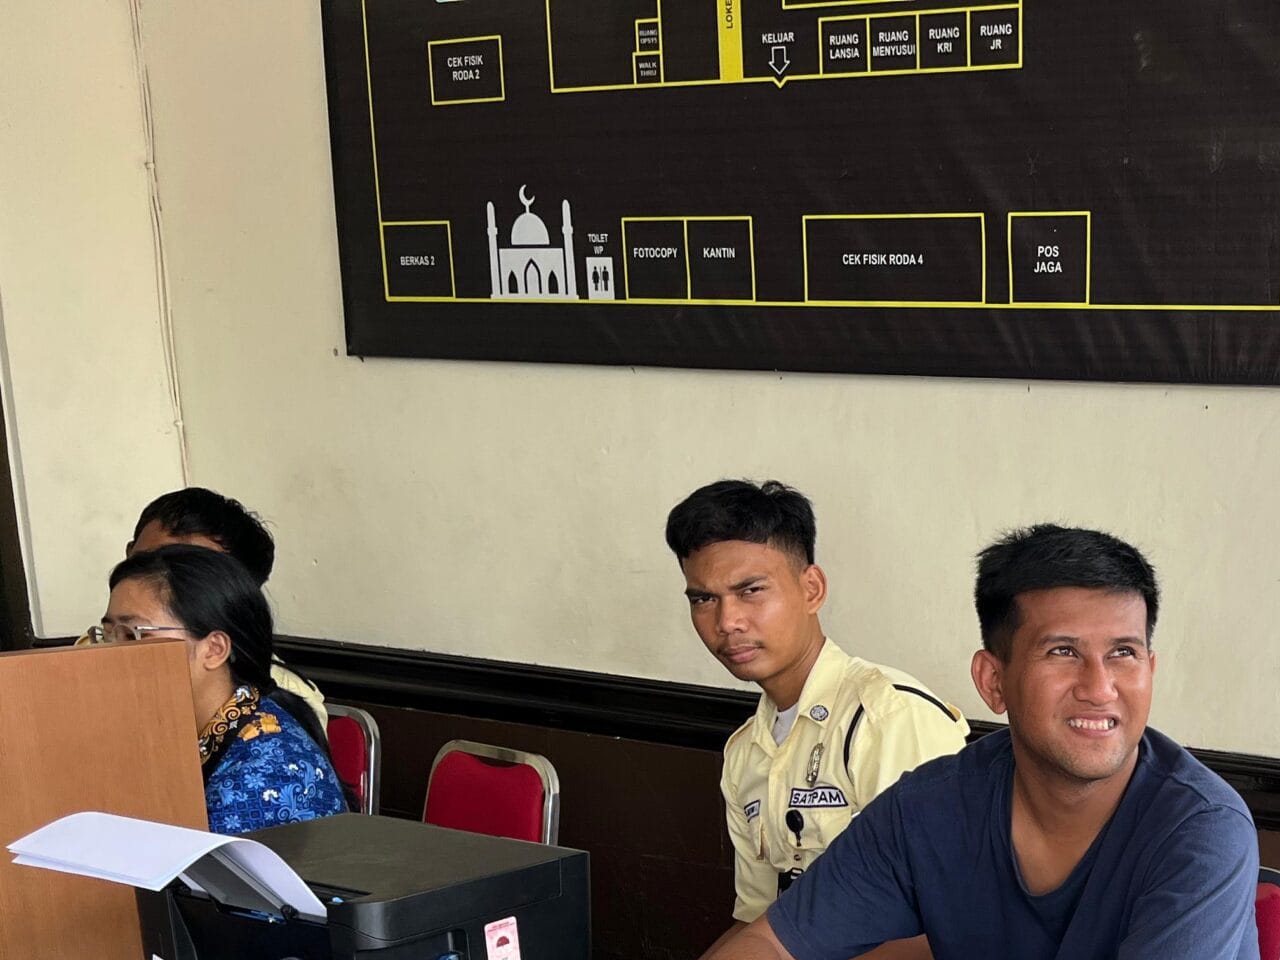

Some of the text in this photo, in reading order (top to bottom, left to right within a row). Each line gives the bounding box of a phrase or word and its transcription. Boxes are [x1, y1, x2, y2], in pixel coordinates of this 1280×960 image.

[928, 27, 960, 39] RUANG
[980, 23, 1013, 36] RUANG
[761, 32, 795, 44] KELUAR
[829, 34, 859, 46] RUANG
[878, 30, 909, 42] RUANG
[872, 44, 916, 57] MENYUSUI
[937, 42, 953, 53] KRI
[990, 39, 1002, 50] JR
[829, 48, 860, 59] LANSIA
[447, 55, 483, 68] CEK FISIK
[452, 69, 480, 81] RODA 2
[588, 233, 609, 243] TOILET
[594, 246, 604, 254] WP
[633, 247, 678, 259] FOTOCOPY
[703, 247, 736, 259] KANTIN
[1037, 246, 1059, 258] POS
[400, 256, 435, 266] BERKAS 2
[842, 254, 924, 265] CEK FISIK RODA 4
[1034, 261, 1063, 273] JAGA
[792, 791, 842, 804] SATPAM
